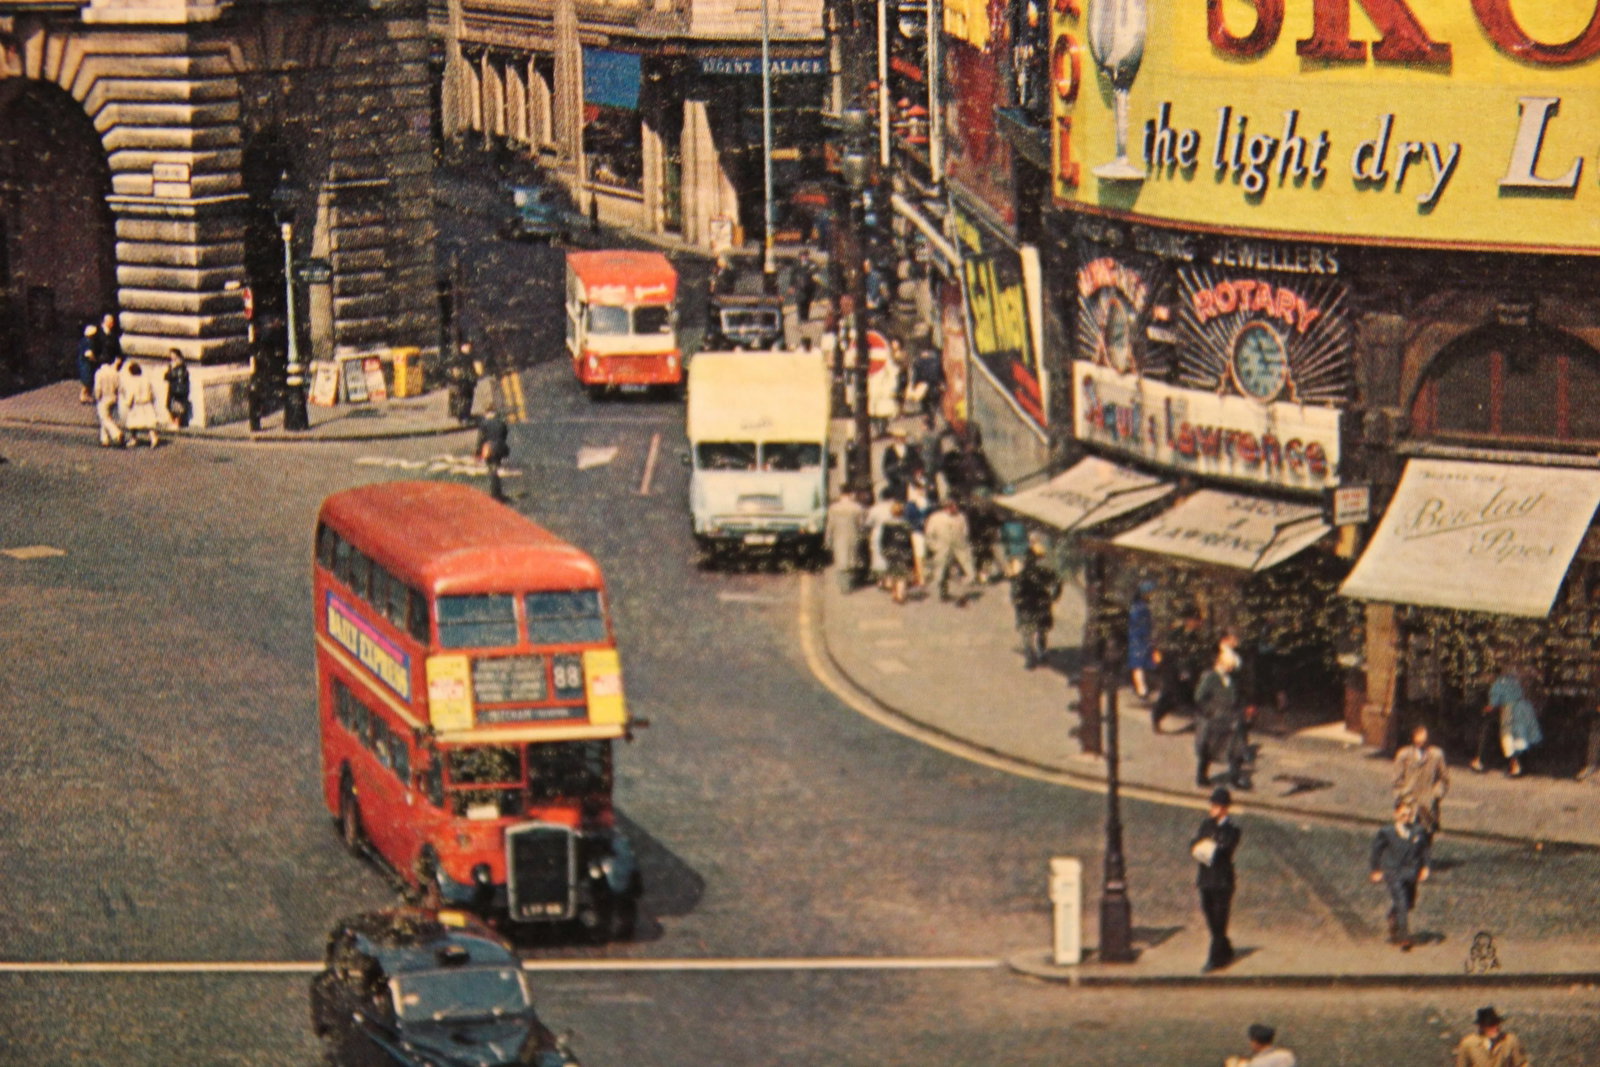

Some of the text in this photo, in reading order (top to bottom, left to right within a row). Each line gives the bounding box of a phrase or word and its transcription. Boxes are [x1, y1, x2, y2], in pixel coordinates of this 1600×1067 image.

[768, 60, 821, 74] ALACE
[1143, 96, 1600, 210] the light dry L
[1211, 243, 1339, 274] JEWELLERS
[1192, 279, 1321, 333] ROTARY
[1163, 395, 1328, 477] Lawrence
[553, 664, 582, 689] 88
